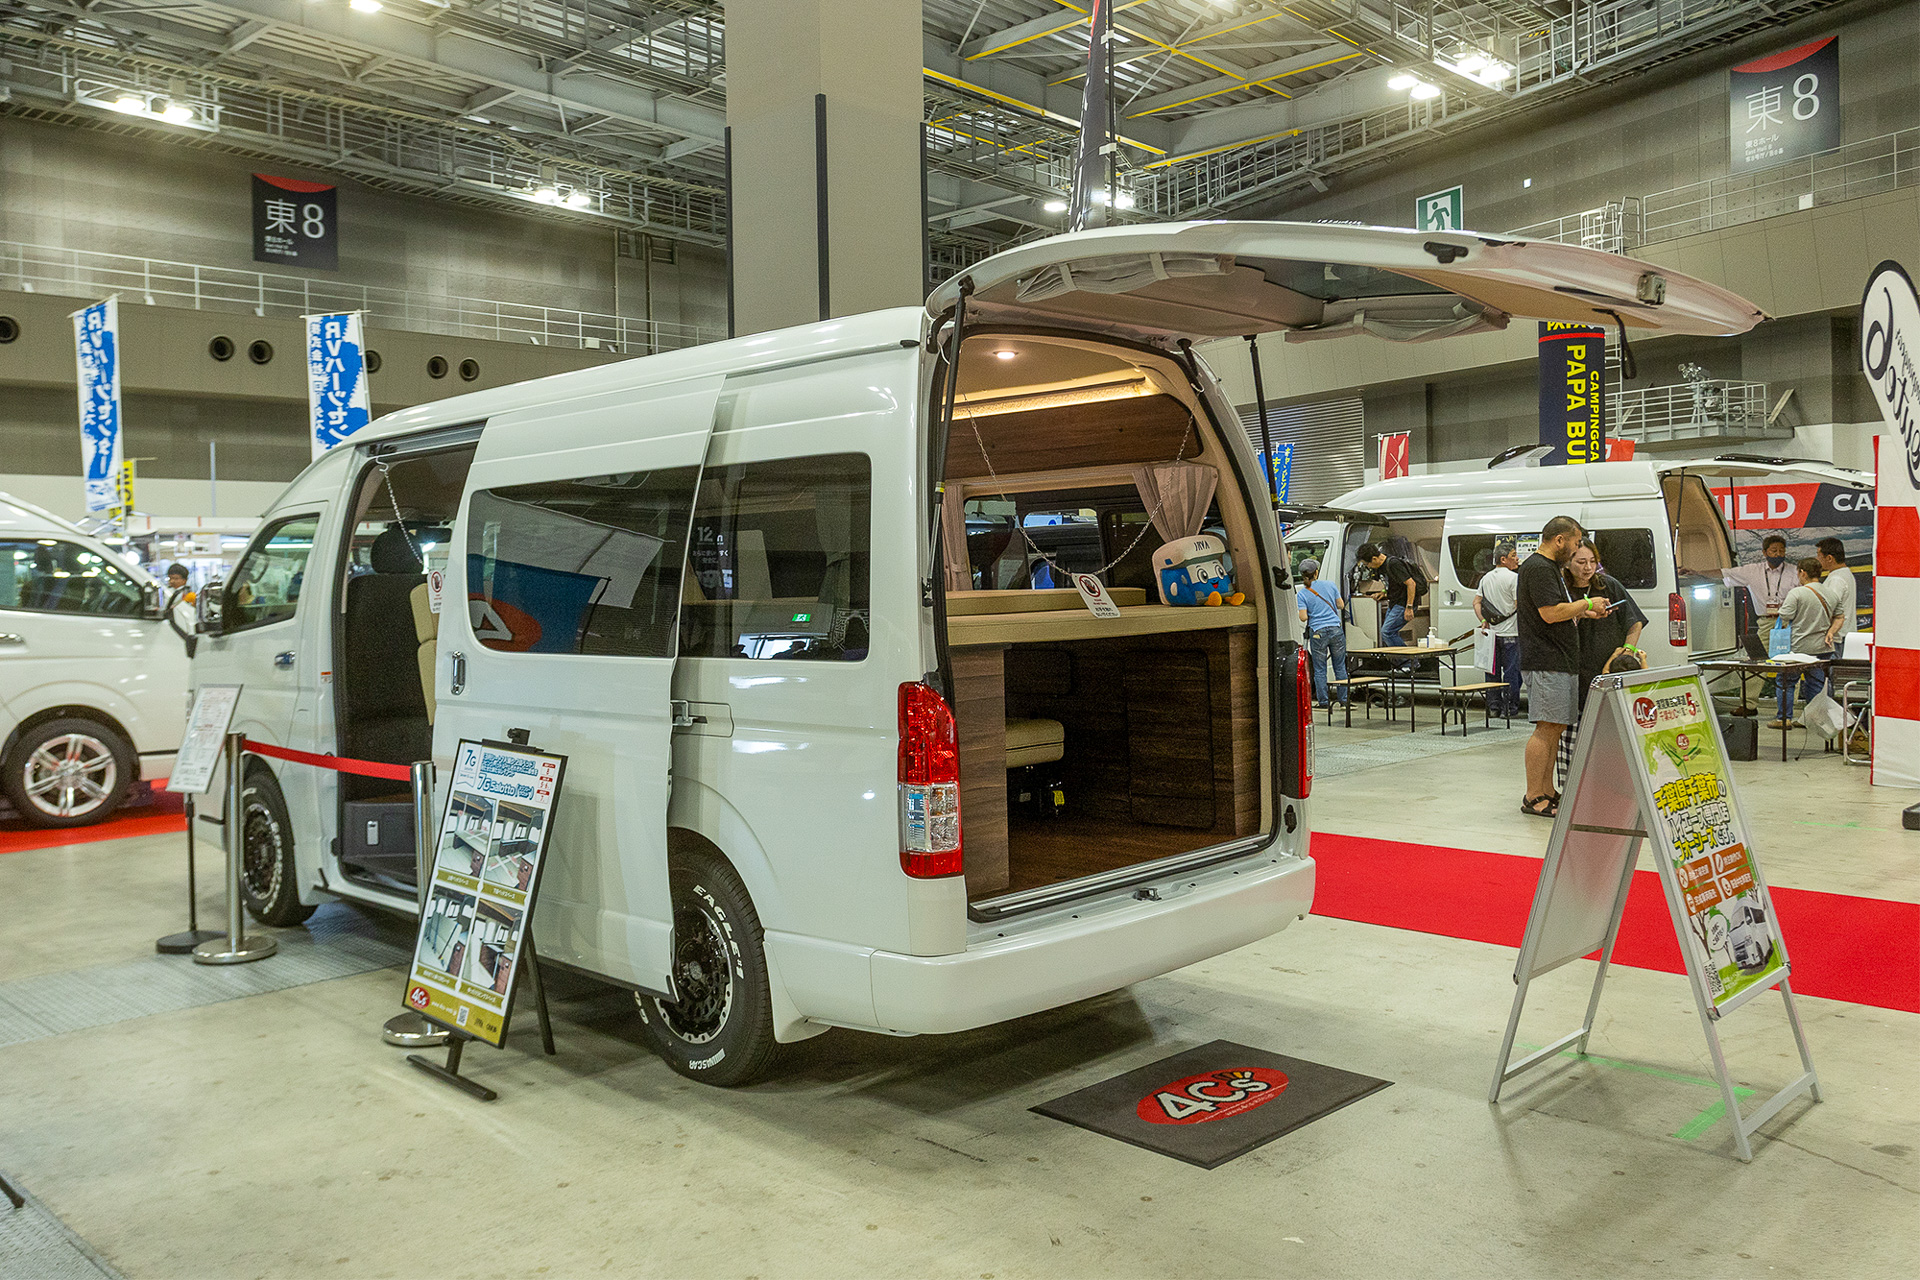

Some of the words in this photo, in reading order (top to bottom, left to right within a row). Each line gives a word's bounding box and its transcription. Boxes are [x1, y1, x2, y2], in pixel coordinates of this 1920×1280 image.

[1567, 344, 1586, 412] PAPA
[1653, 772, 1727, 818] 千葉県千葉市の
[693, 884, 740, 958] EAGLE
[1155, 1076, 1272, 1120] 4Cs
